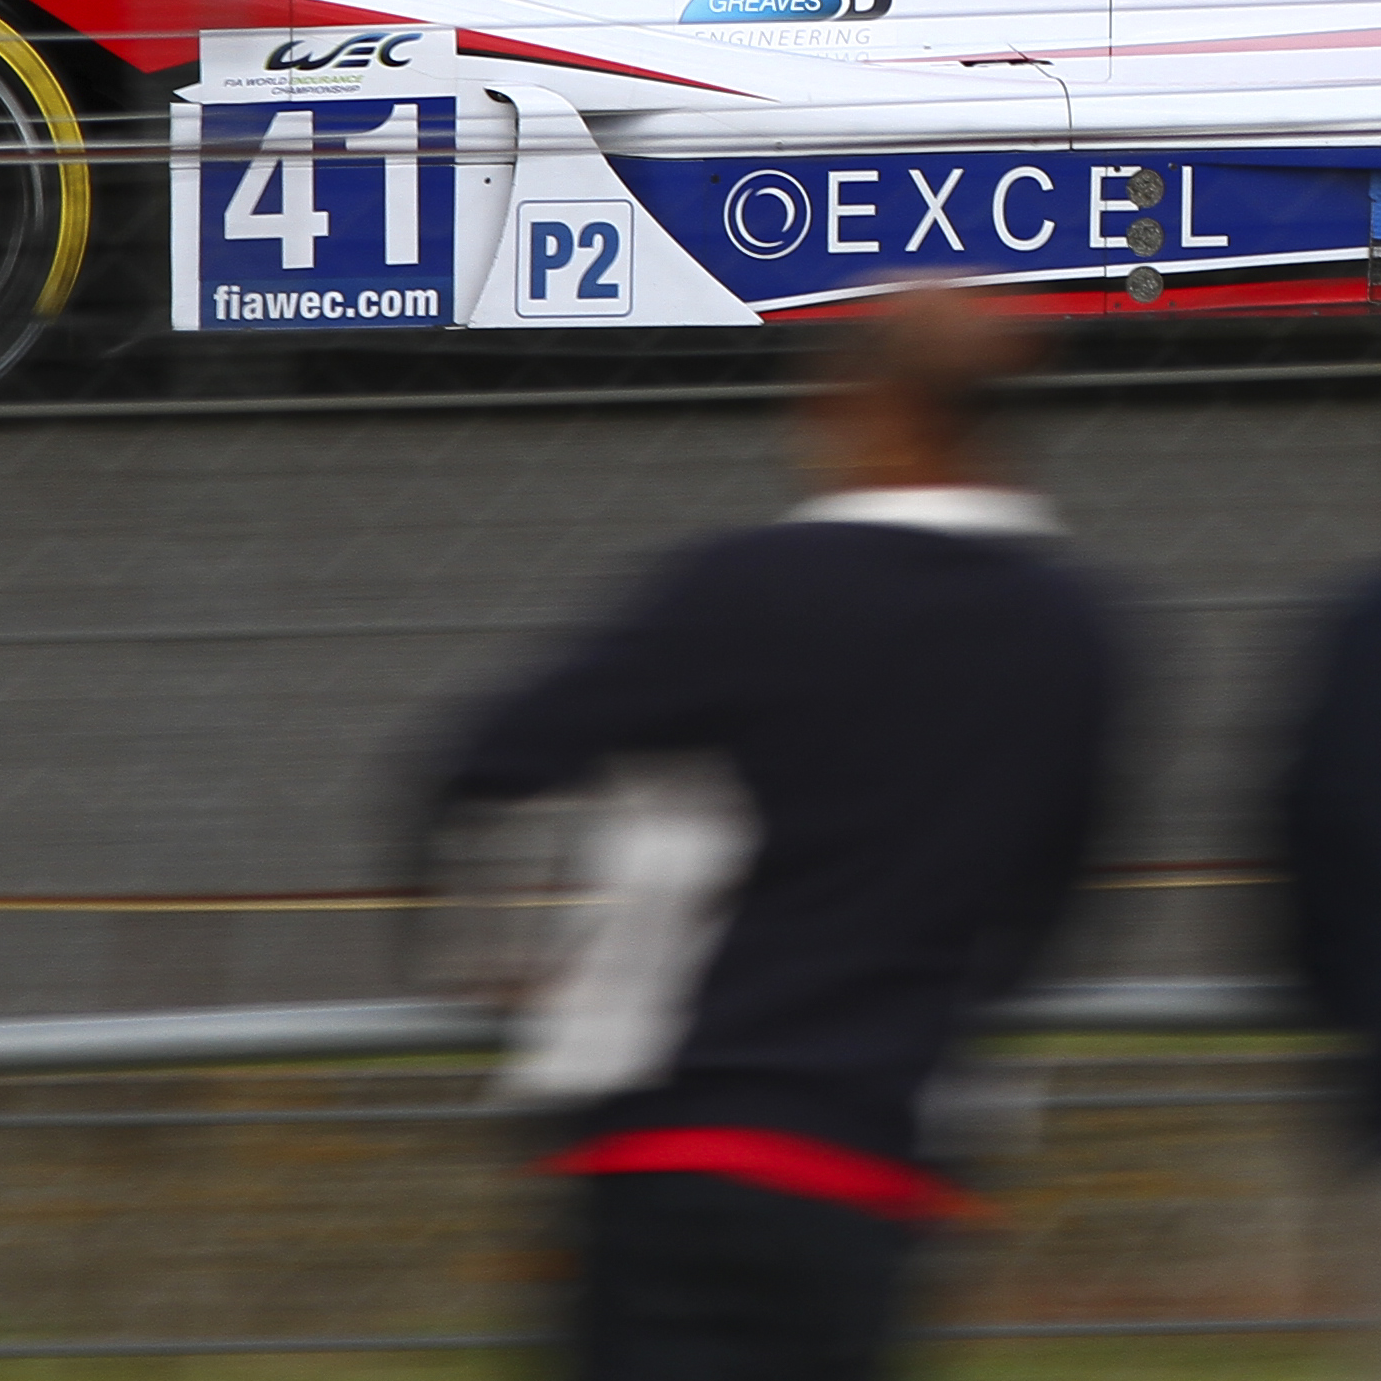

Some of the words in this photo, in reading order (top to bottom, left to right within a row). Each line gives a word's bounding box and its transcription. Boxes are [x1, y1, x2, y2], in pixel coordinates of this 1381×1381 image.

[264, 32, 424, 71] WEC
[224, 103, 420, 270] 41
[827, 165, 1229, 254] EXCEL
[530, 221, 620, 301] P2
[213, 285, 438, 320] fiawec.com
